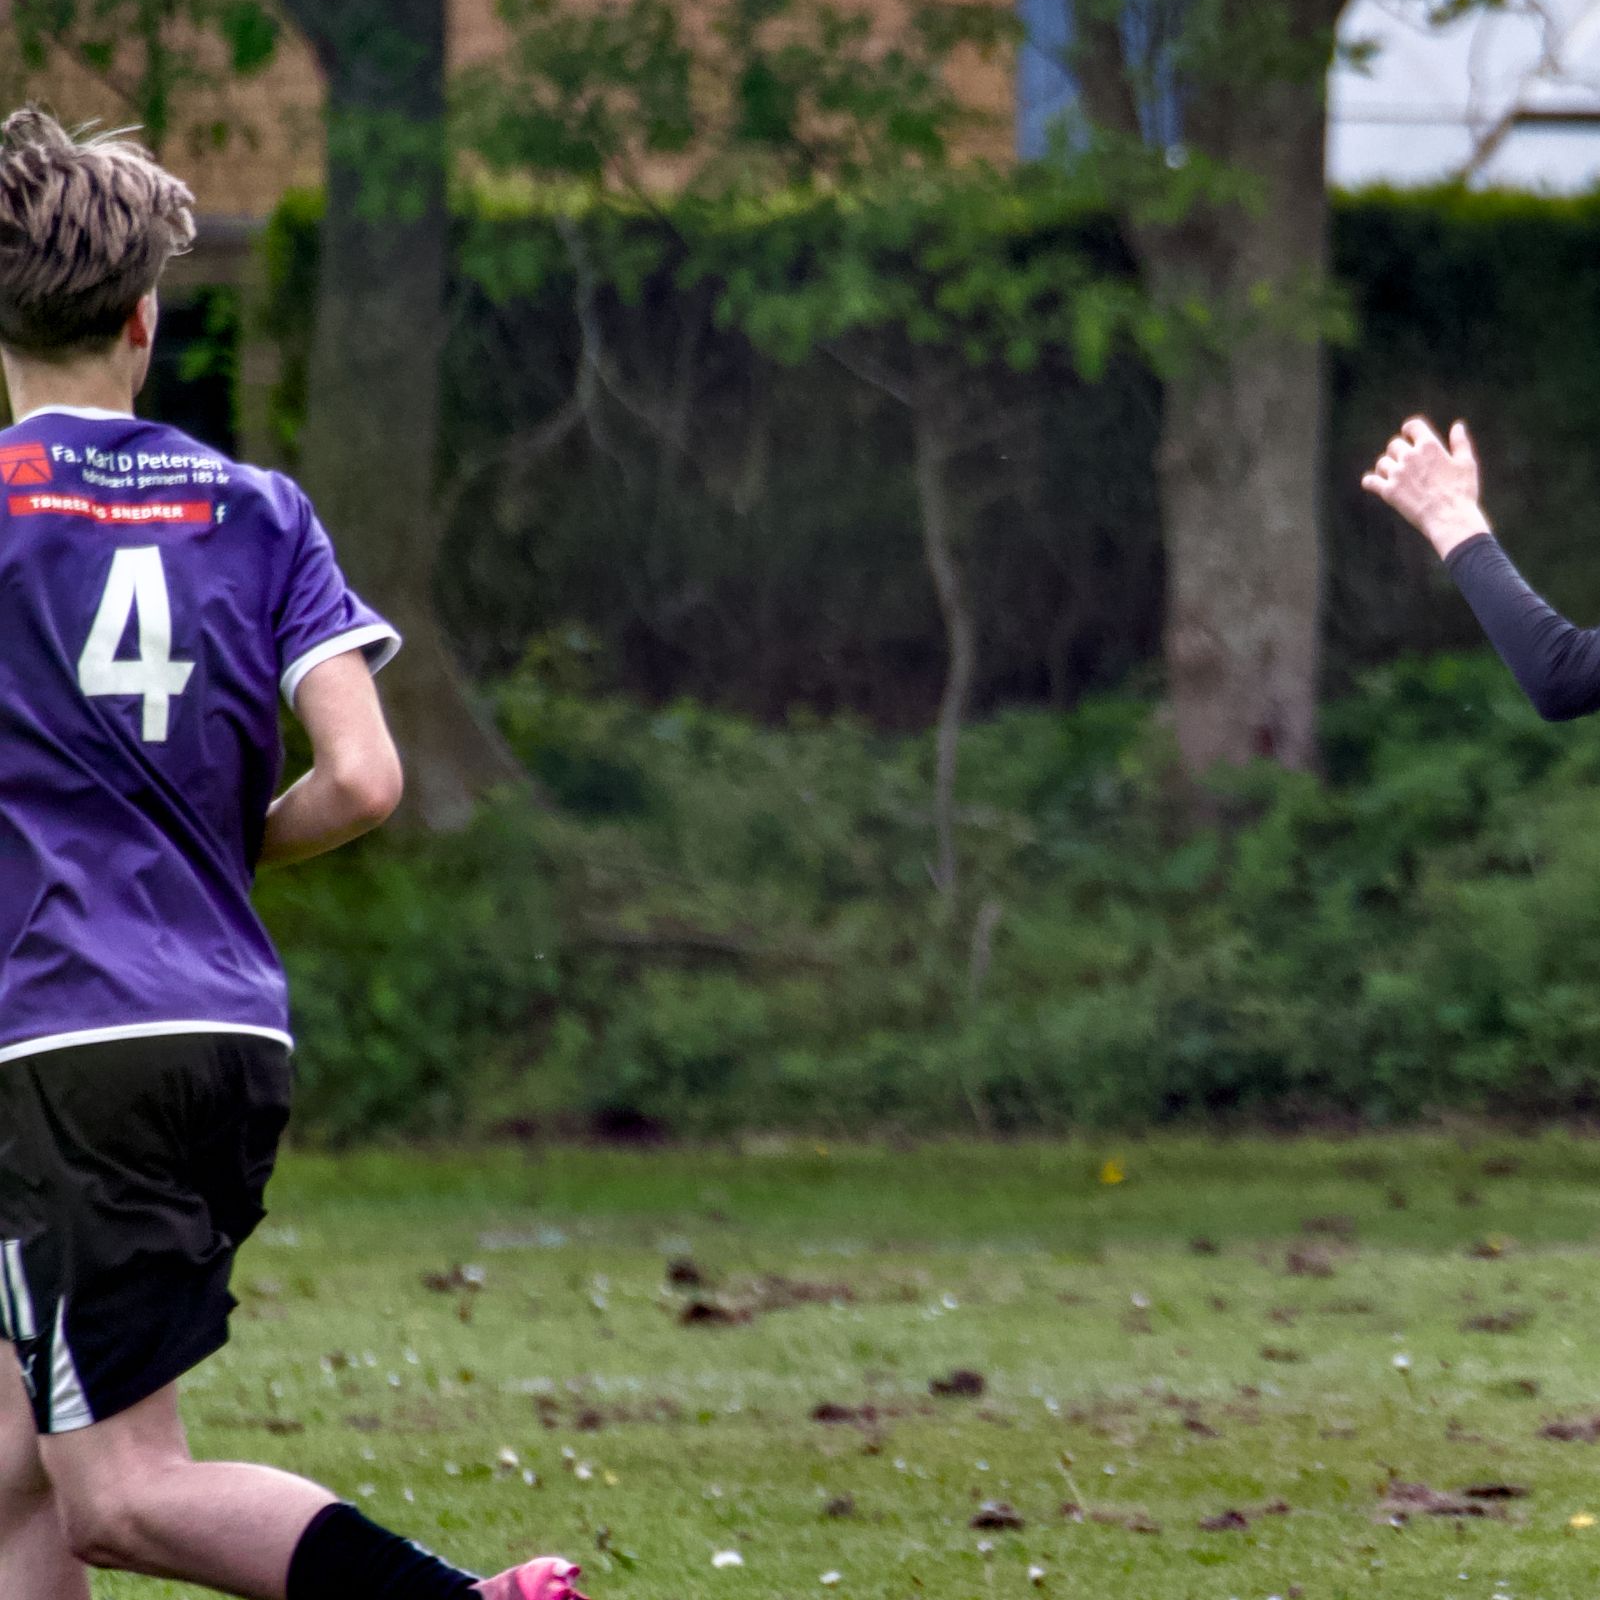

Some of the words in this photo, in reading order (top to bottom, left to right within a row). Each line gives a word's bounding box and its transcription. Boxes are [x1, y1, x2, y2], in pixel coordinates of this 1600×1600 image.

[51, 444, 82, 463] Fa.
[85, 446, 115, 472] Karl
[117, 453, 133, 473] D
[137, 451, 223, 472] Petersen
[111, 504, 184, 520] SNEDKER
[77, 545, 196, 742] 4
